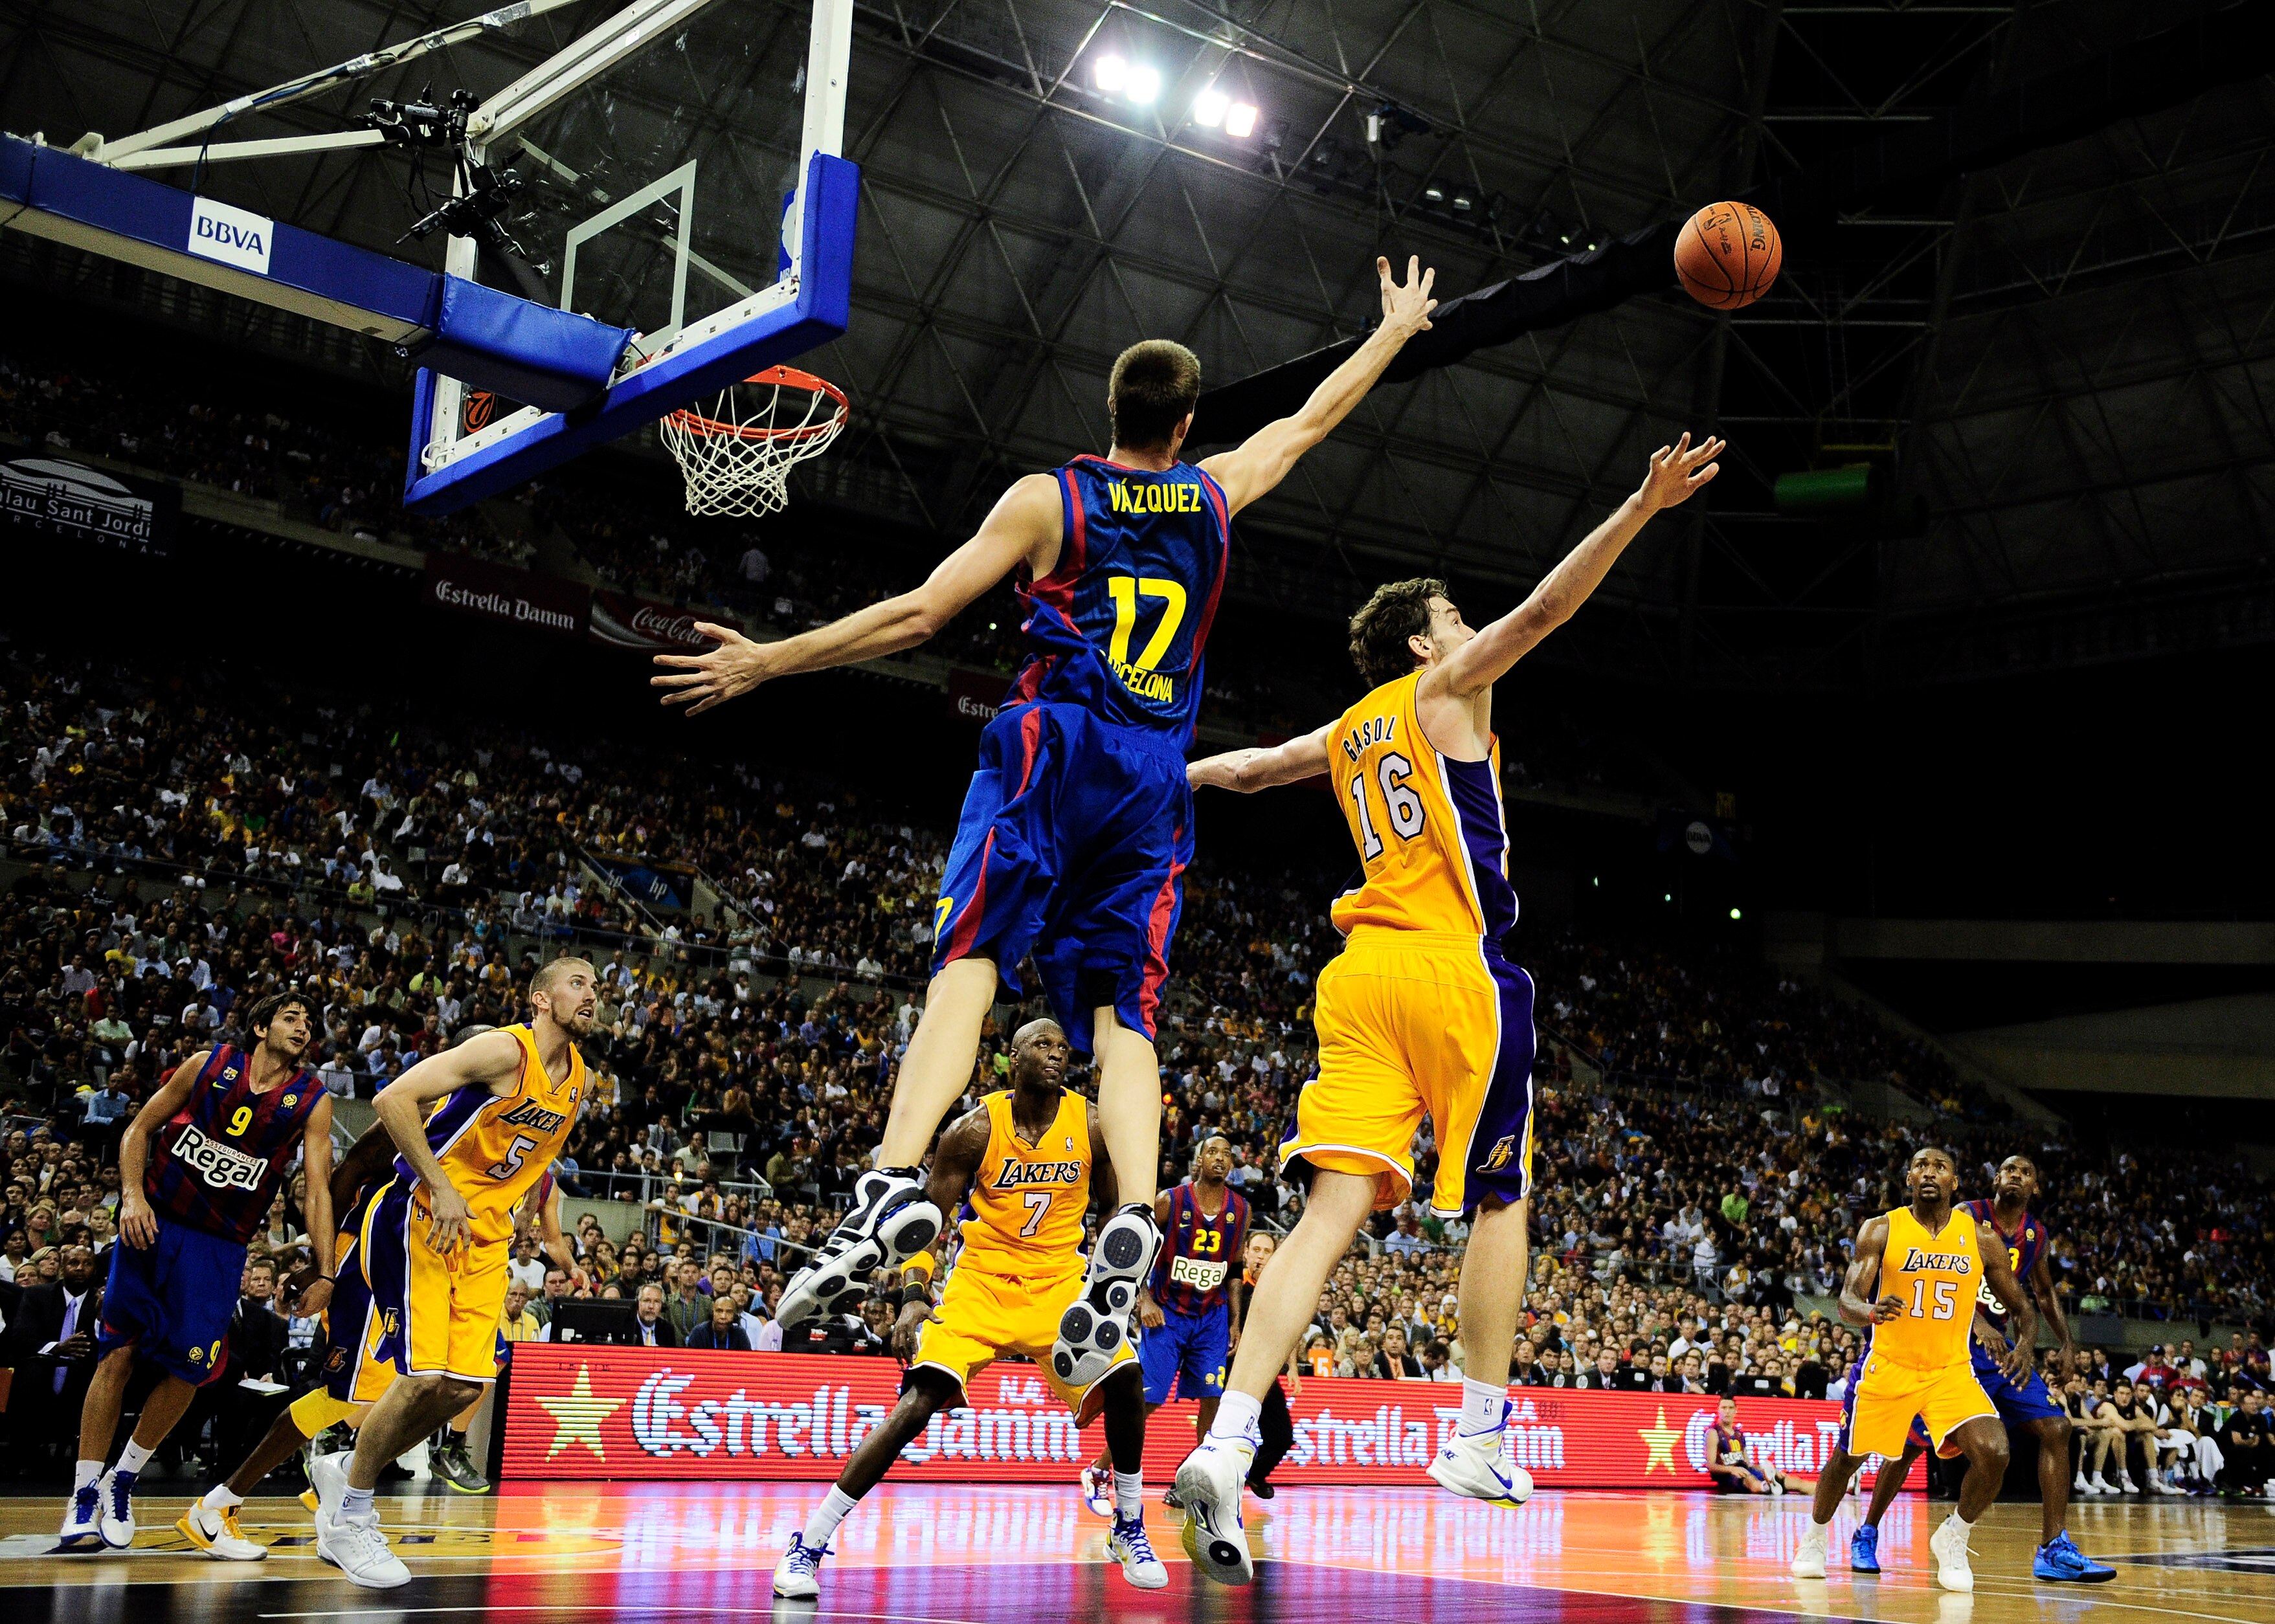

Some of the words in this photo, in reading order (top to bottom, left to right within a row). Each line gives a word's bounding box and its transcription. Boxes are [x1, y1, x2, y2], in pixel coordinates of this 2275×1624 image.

[197, 216, 264, 256] BBVA
[1108, 478, 1201, 513] VÁZQUEZ
[47, 499, 93, 524] Sant
[101, 513, 151, 537] Jordi
[436, 580, 510, 616] Estrella
[515, 598, 575, 630] Damm
[1108, 576, 1187, 671] 17
[1343, 717, 1396, 762] GASOL
[1350, 750, 1427, 863] 16
[648, 875, 667, 901] hp
[226, 1106, 252, 1137] 9
[175, 1126, 265, 1187] Regal
[205, 1139, 258, 1164] ASSEGURANCES
[484, 1133, 539, 1181] 5
[992, 1158, 1082, 1188] LAKERS
[1019, 1192, 1053, 1238] 7
[1193, 1229, 1222, 1252] 23
[1900, 1248, 1971, 1275] LAKERS
[1910, 1279, 1957, 1320] 15
[632, 1367, 886, 1458] Estrella
